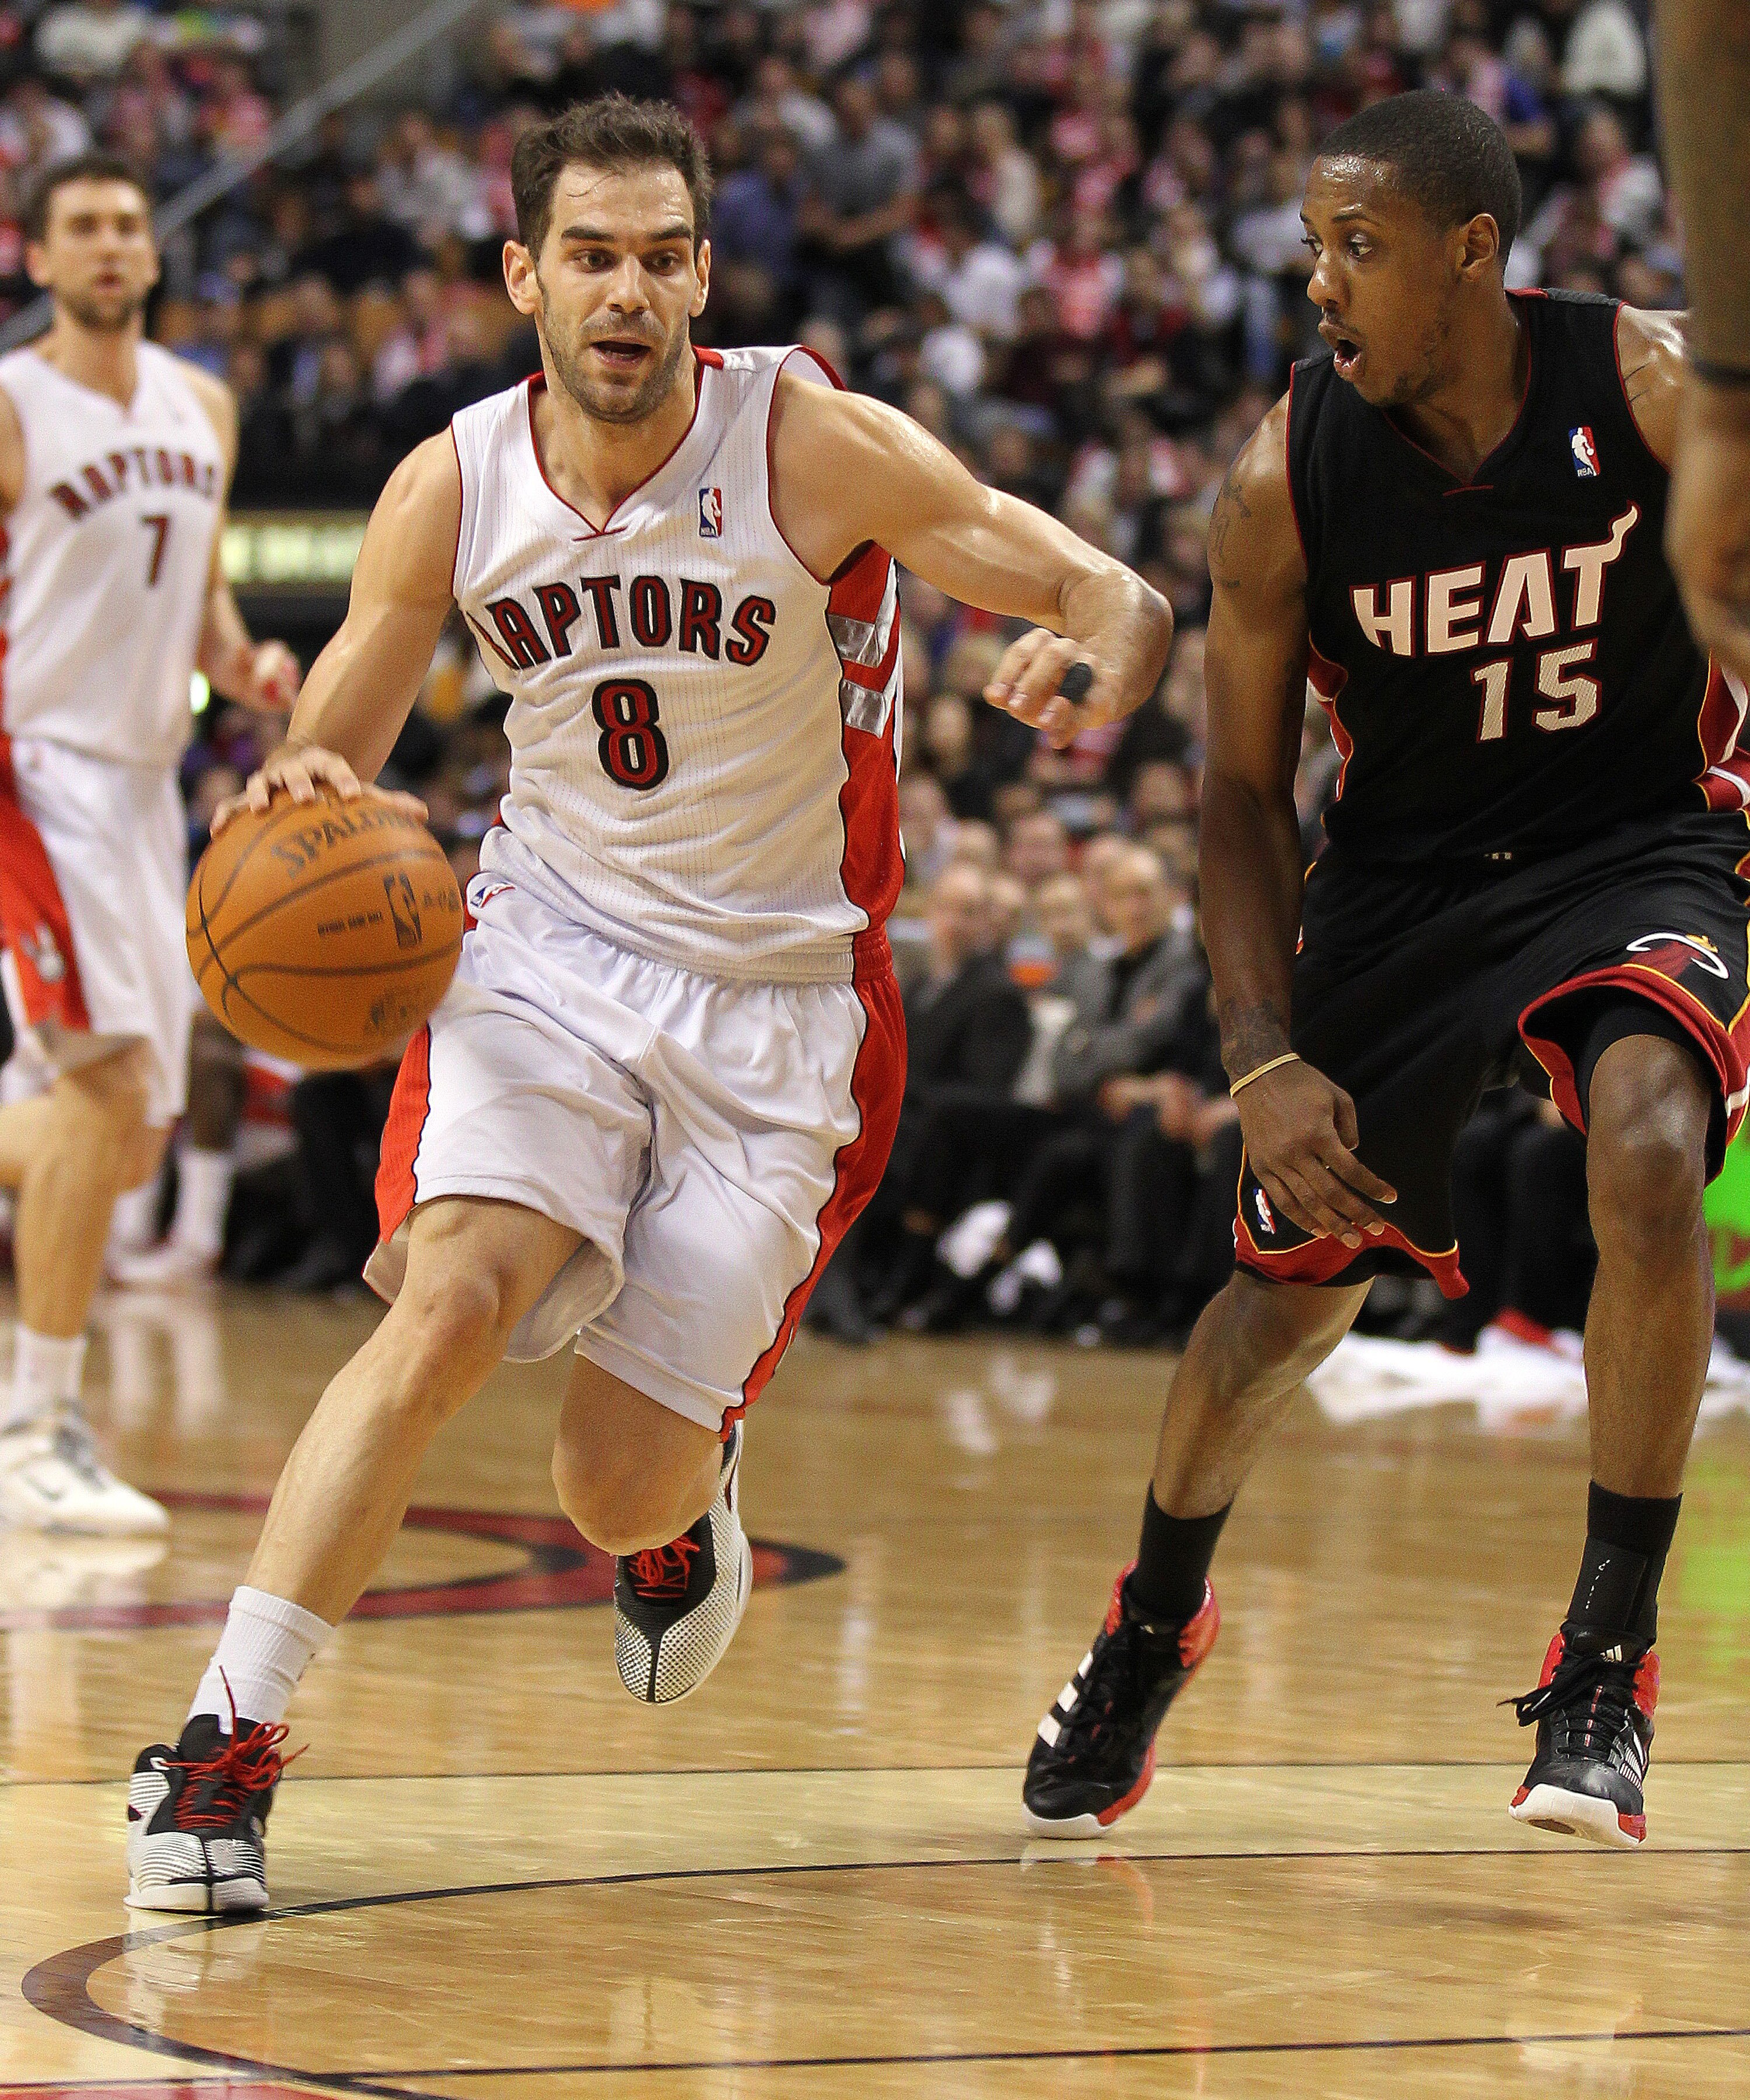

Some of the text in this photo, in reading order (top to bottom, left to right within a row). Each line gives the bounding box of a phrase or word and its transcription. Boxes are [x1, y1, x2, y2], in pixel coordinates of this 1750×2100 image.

[138, 513, 172, 588] 7
[1349, 499, 1642, 659] HEAT
[592, 678, 669, 791] 8
[1471, 638, 1602, 743] 15
